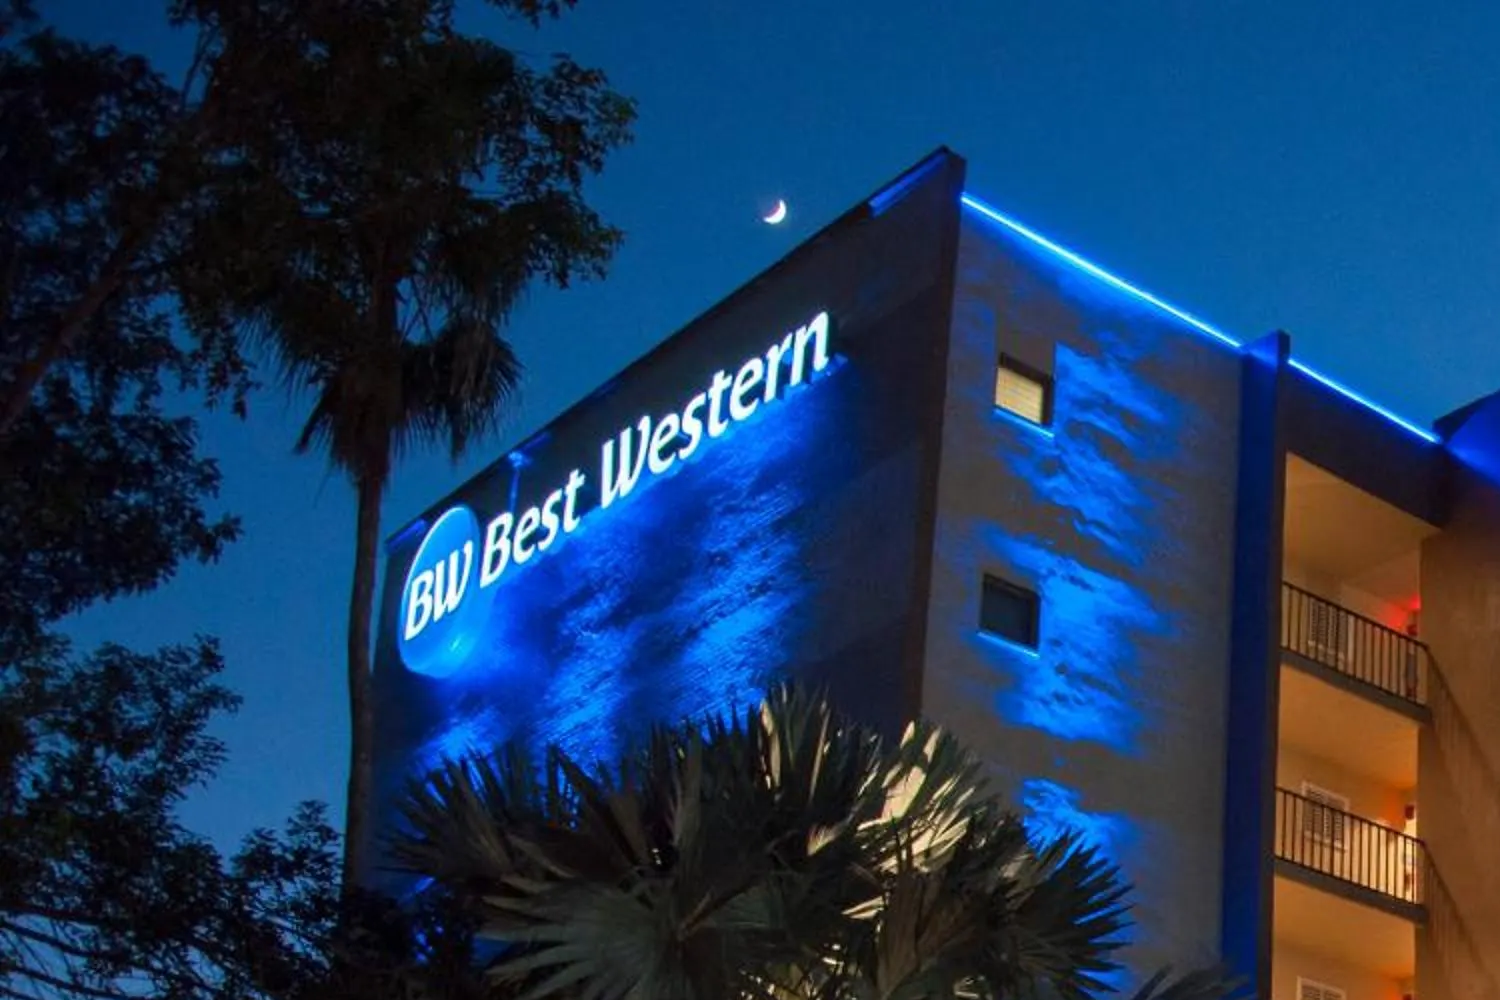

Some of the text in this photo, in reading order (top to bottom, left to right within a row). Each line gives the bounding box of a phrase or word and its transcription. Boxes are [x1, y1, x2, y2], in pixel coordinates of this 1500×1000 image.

[480, 312, 829, 588] Best Western
[405, 541, 473, 641] BW
